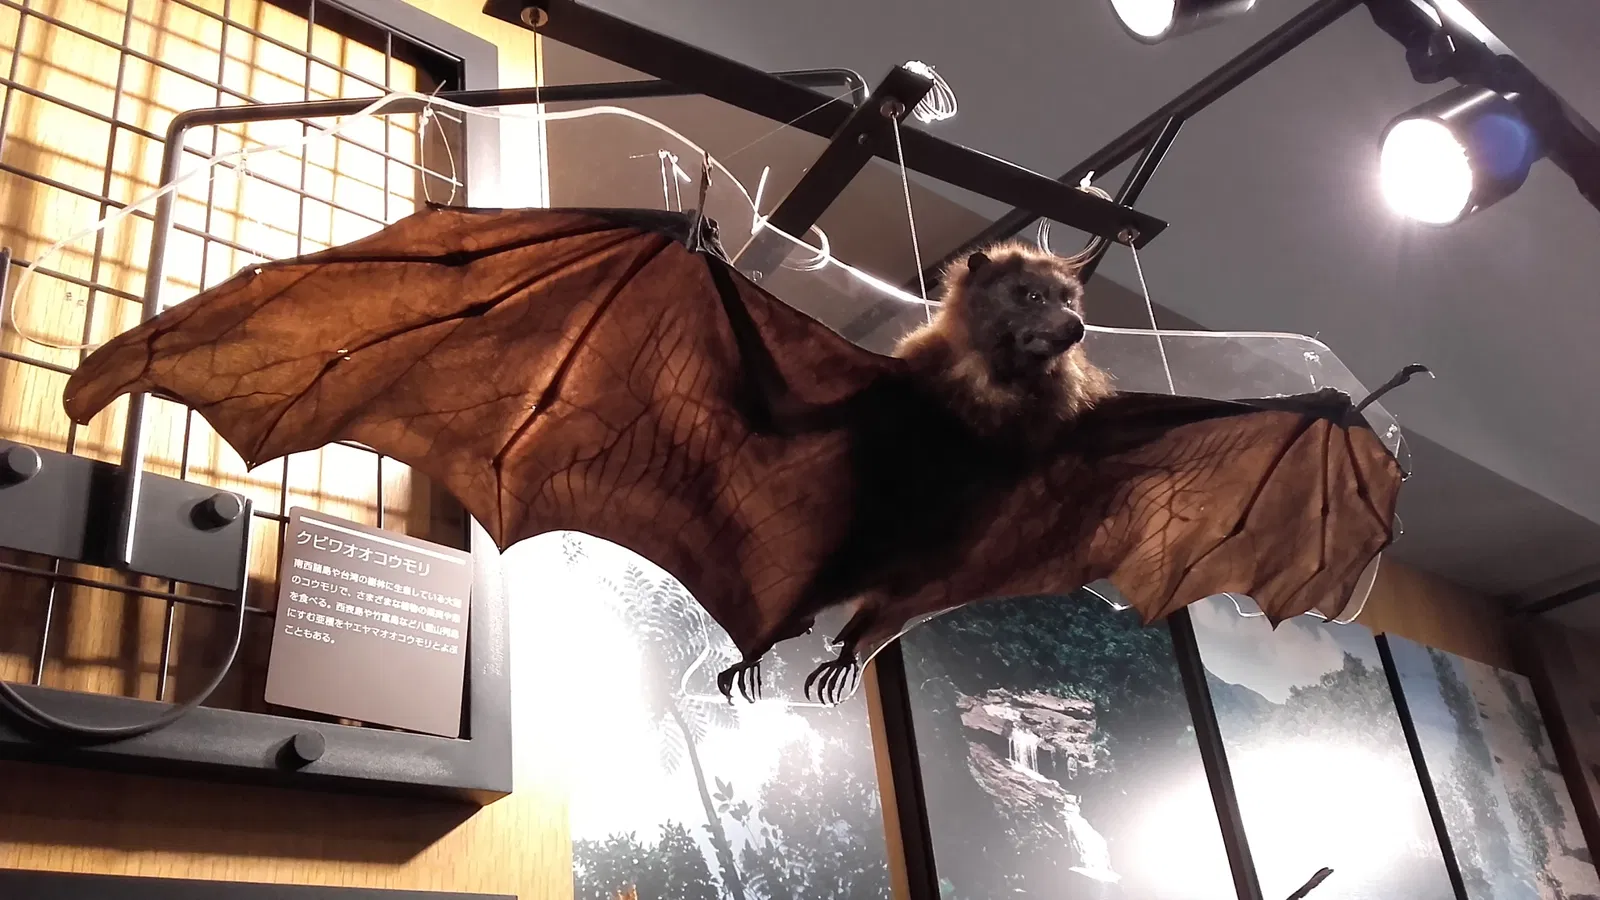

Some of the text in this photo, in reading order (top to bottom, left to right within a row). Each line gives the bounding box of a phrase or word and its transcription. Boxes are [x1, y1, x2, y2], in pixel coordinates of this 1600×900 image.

[297, 530, 431, 577] クビワオオコウモリ
[284, 624, 336, 644] こともある。
